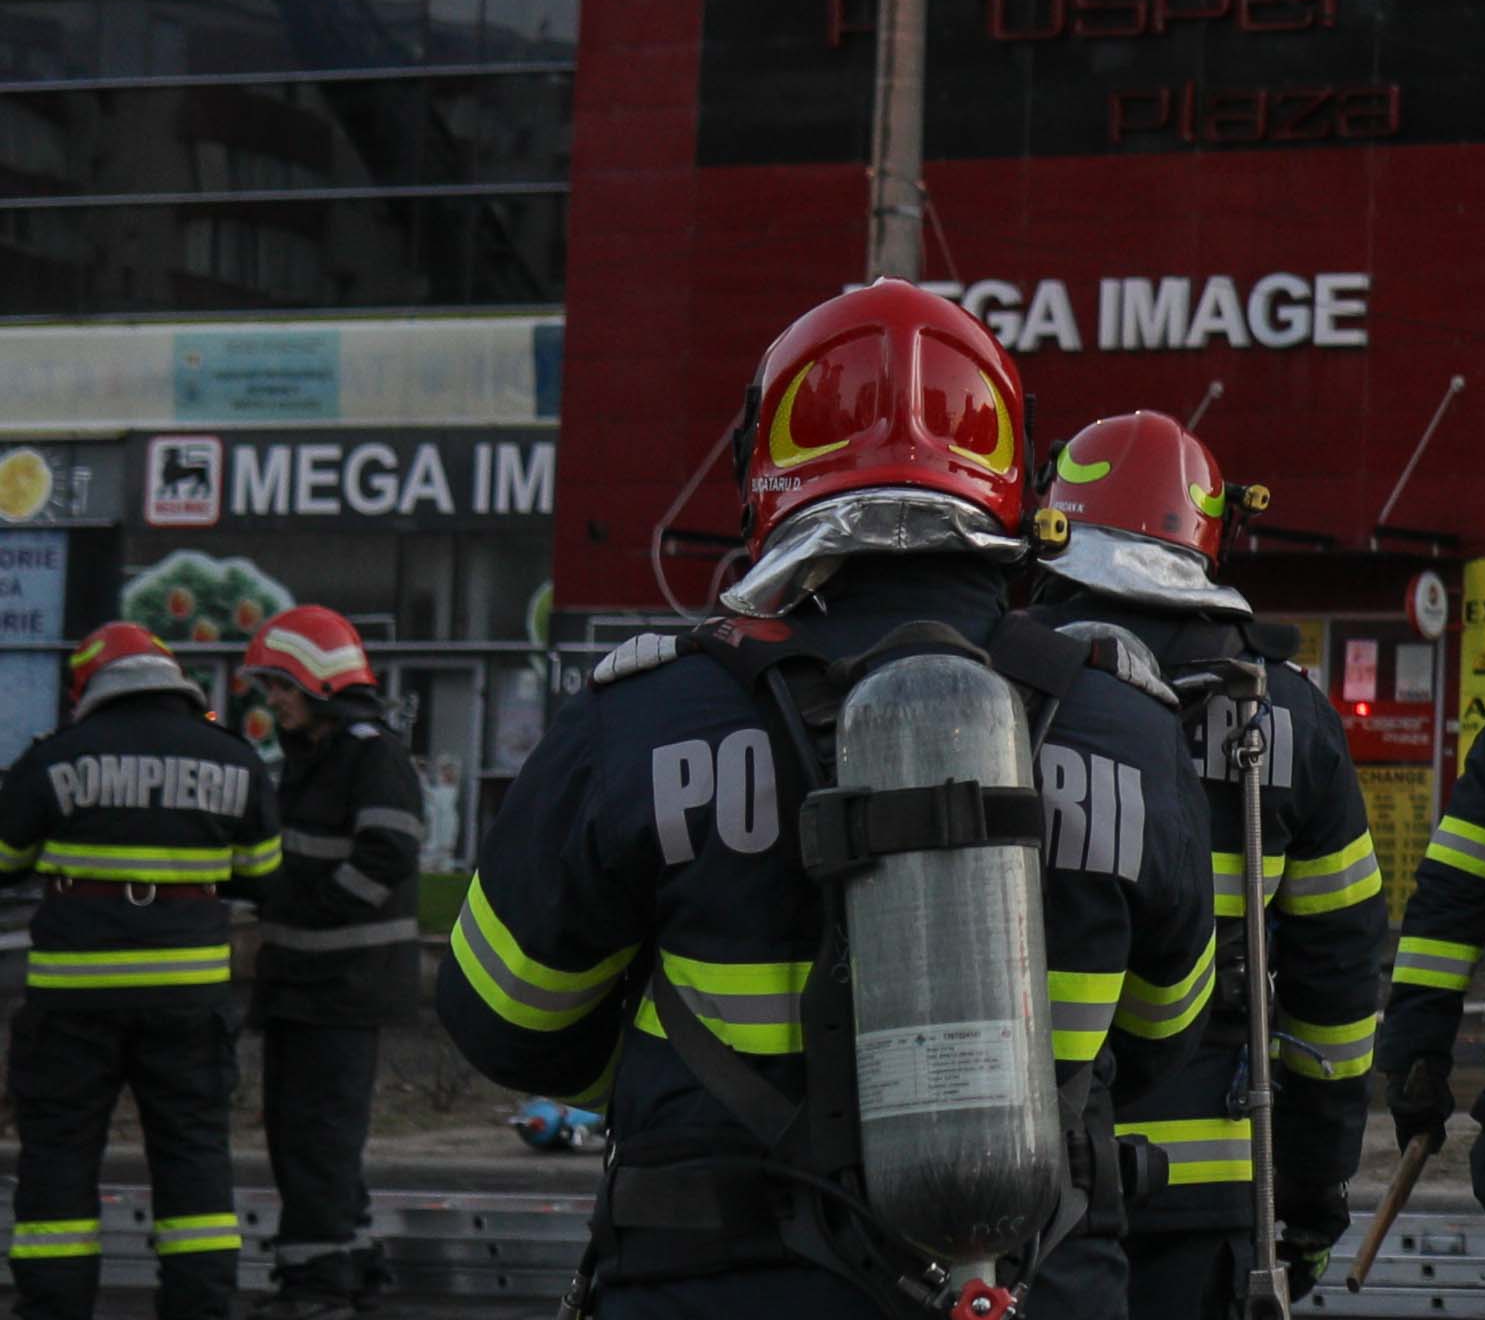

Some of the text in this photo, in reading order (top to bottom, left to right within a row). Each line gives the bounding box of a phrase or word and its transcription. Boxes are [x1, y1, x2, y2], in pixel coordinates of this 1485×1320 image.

[1106, 77, 1402, 144] plaza
[1099, 273, 1374, 350] IMAGE
[230, 443, 453, 516] MEGA
[48, 754, 250, 818] POMPIERII
